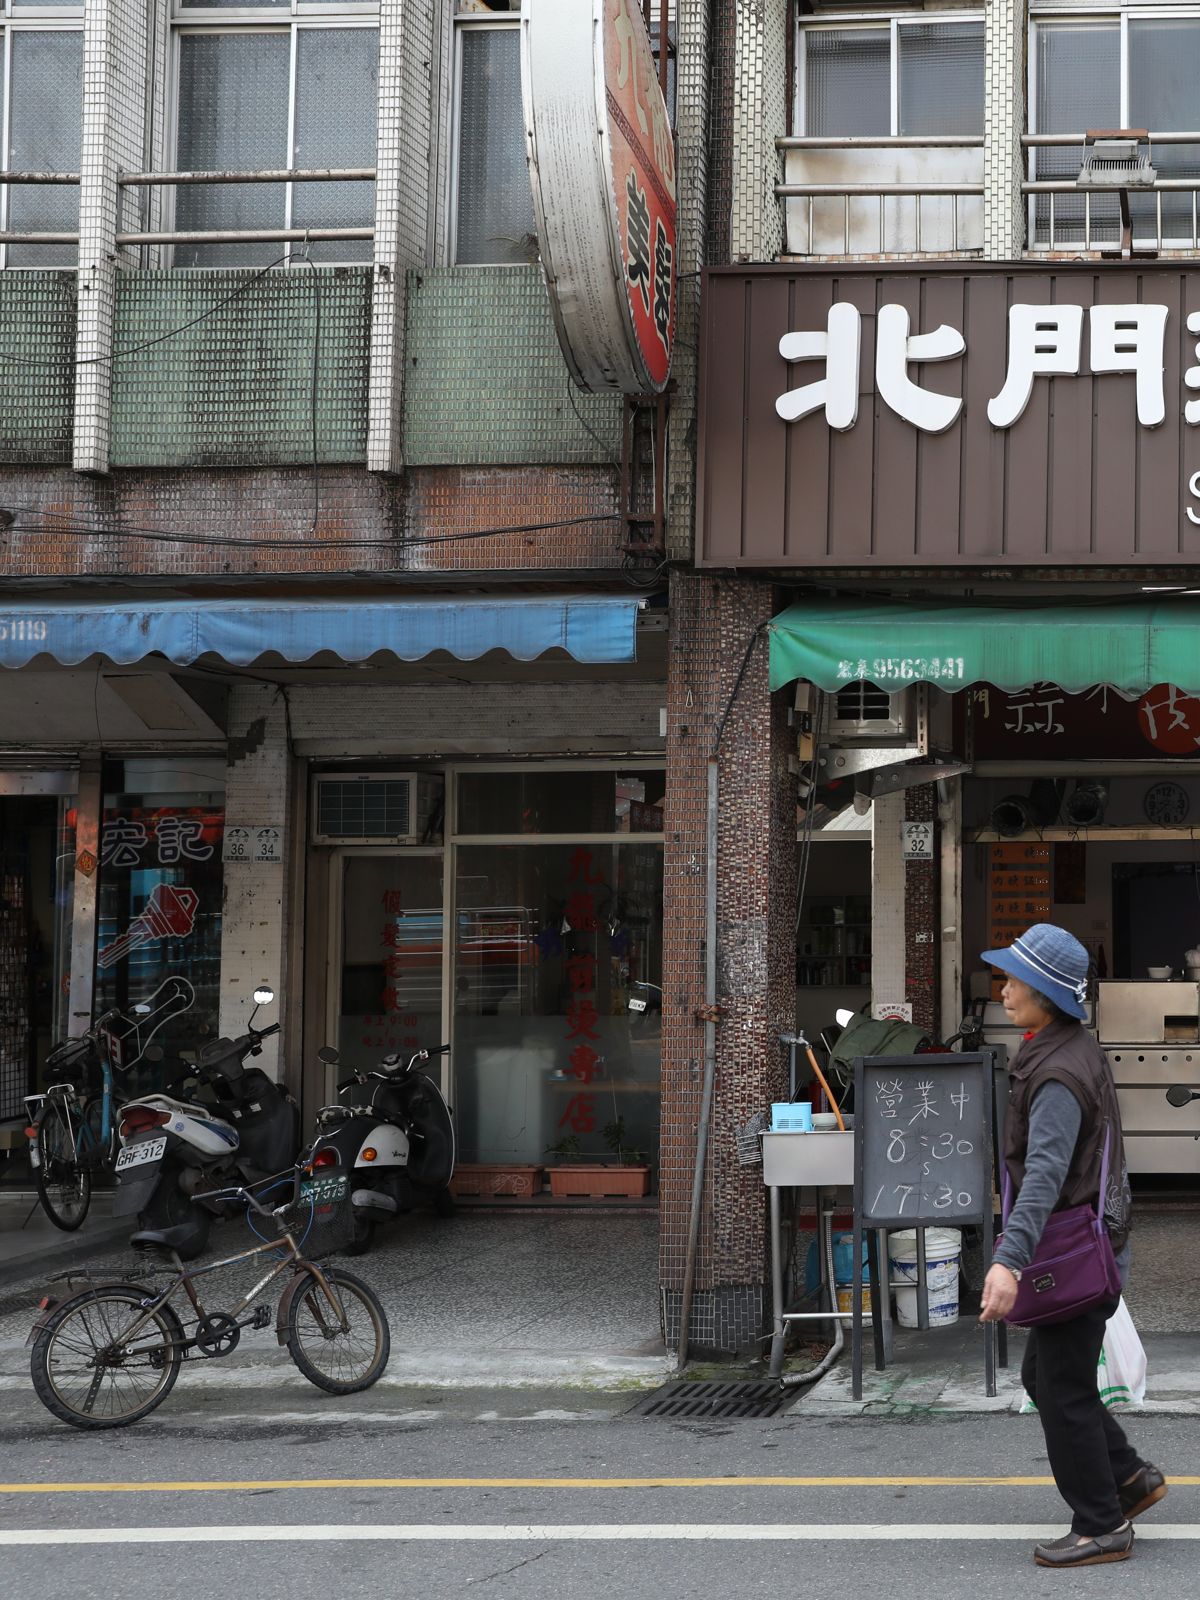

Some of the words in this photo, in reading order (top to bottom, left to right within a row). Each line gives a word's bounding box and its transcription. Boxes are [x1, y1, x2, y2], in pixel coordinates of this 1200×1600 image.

[231, 844, 244, 855] 36
[261, 844, 274, 855] 34
[911, 840, 924, 851] 32
[875, 1078, 971, 1127] 營業中
[117, 1144, 163, 1167] GRF-312
